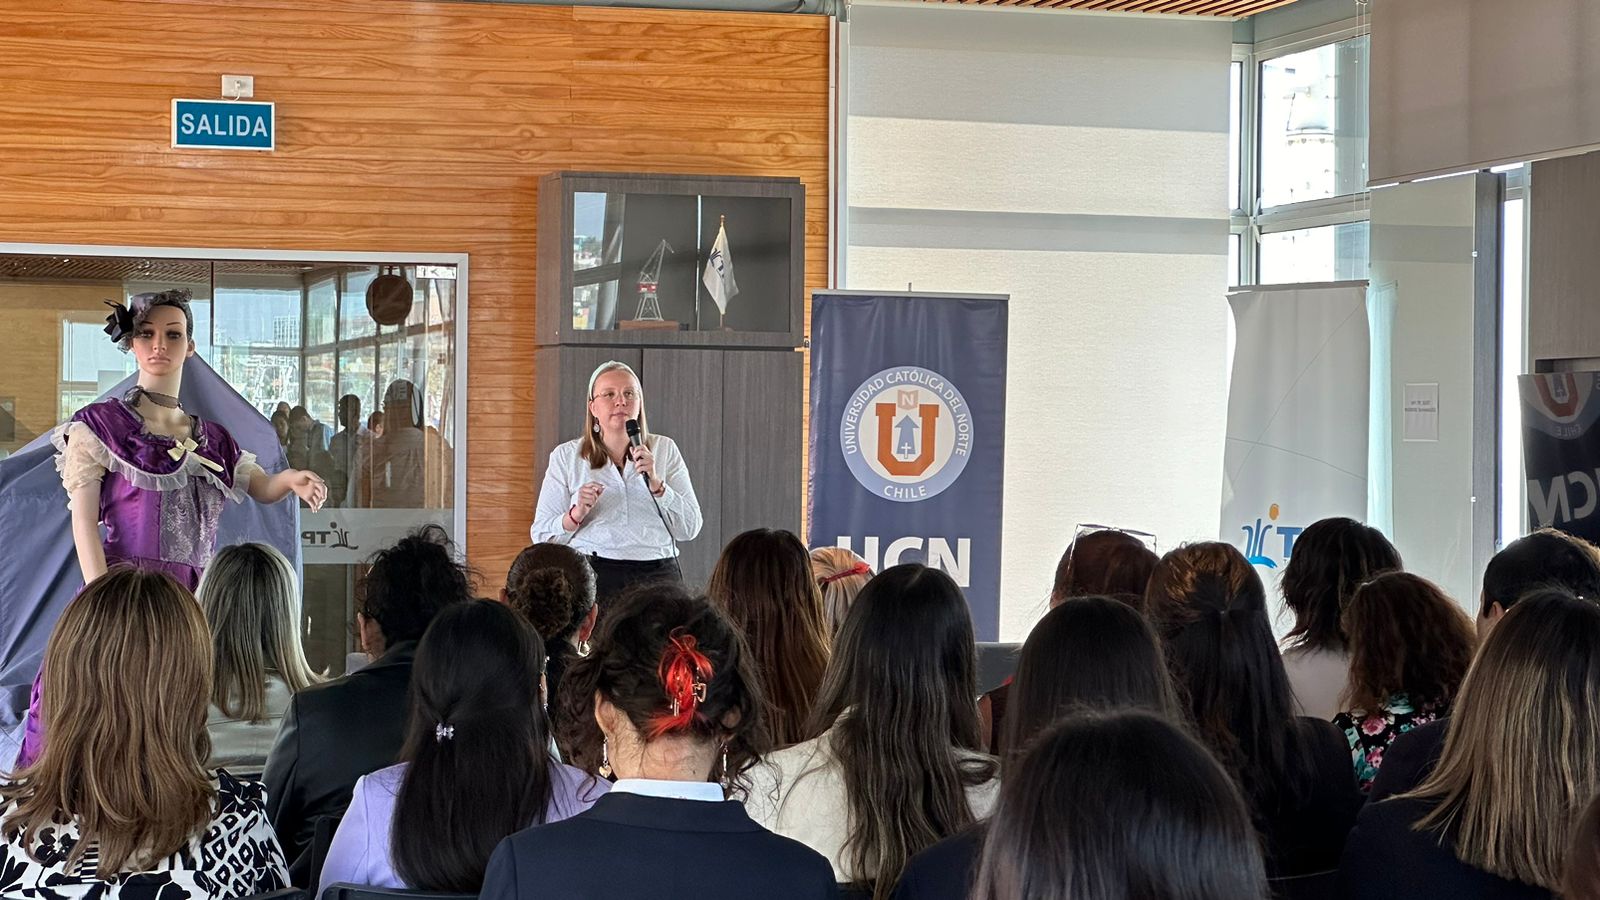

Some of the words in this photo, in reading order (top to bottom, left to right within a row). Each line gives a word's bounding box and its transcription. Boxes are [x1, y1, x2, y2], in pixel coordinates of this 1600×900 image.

[181, 112, 268, 137] SALIDA
[901, 394, 914, 406] N
[844, 378, 885, 455] UNIVERSIDAD
[885, 369, 945, 393] CATÓLICA
[943, 389, 959, 413] DEL
[955, 413, 969, 457] NORTE
[883, 485, 927, 499] CHILE
